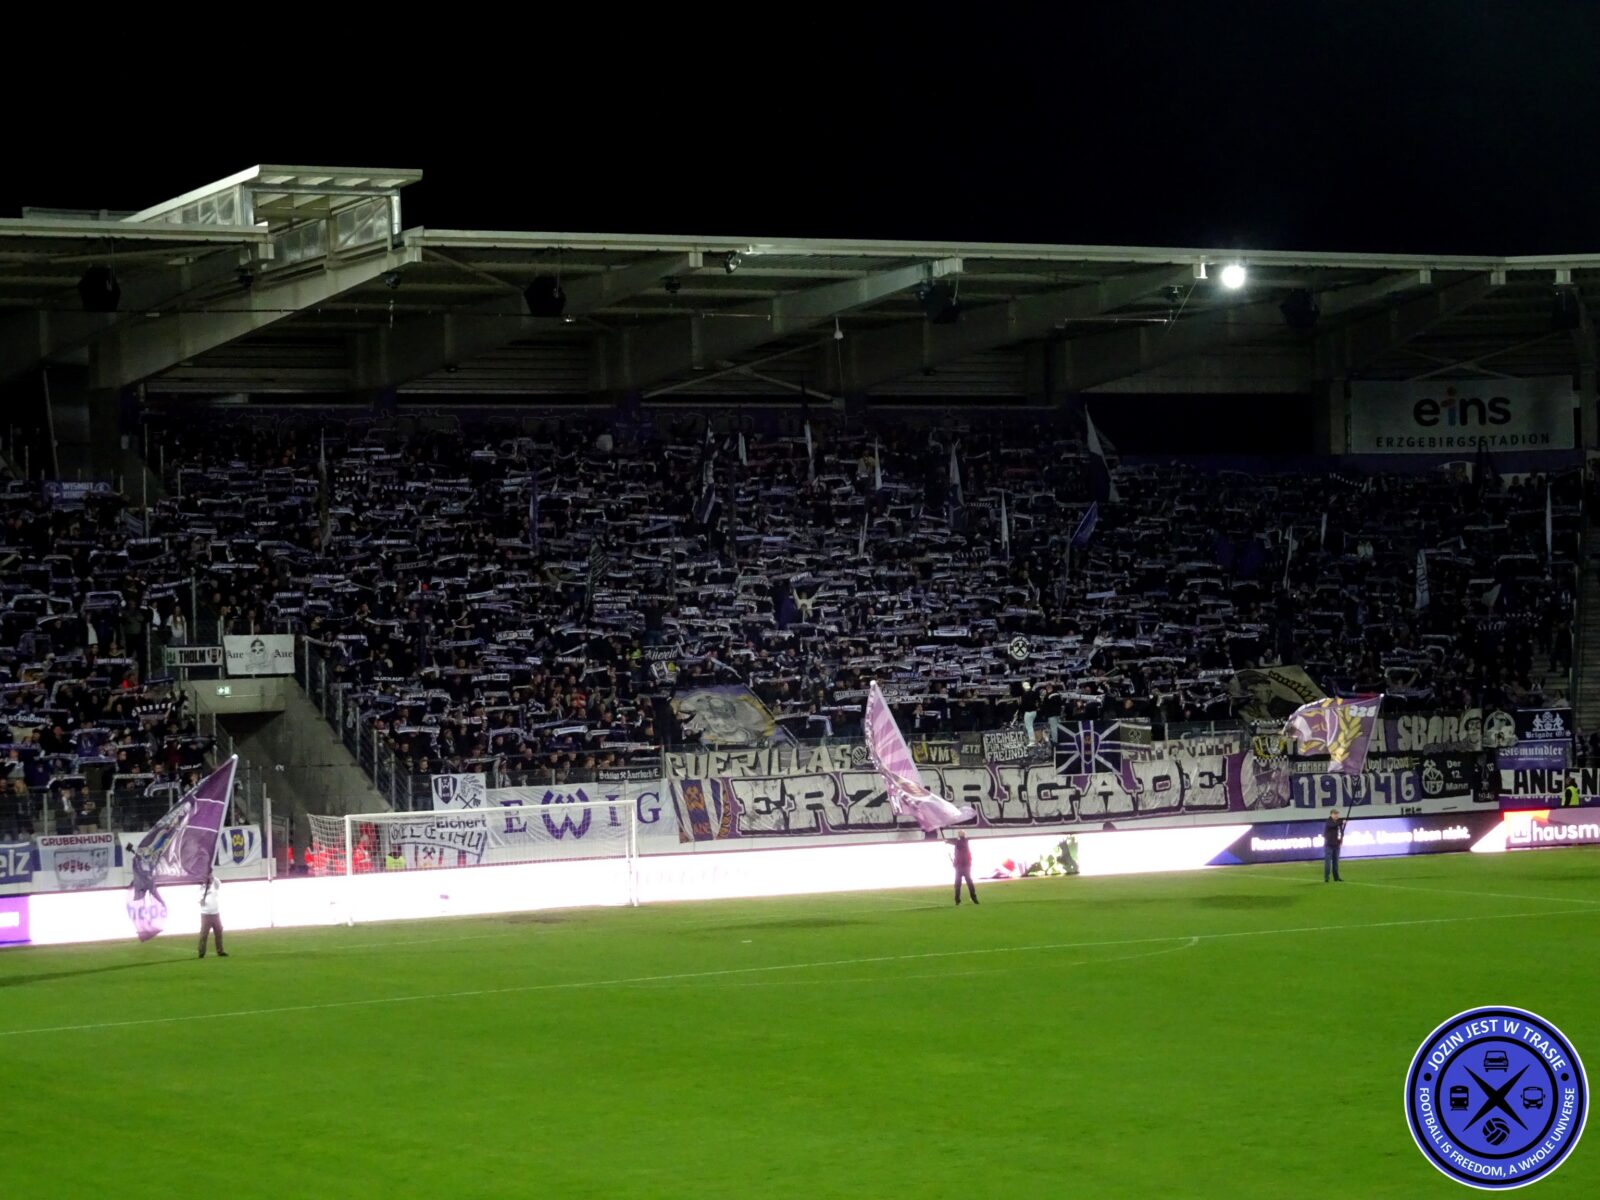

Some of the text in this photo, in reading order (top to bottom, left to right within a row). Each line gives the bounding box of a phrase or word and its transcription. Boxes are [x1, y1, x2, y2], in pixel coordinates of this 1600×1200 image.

[1413, 386, 1511, 426] eins
[1377, 432, 1550, 448] ERZGEBIRGSSTADION
[274, 649, 293, 658] Aue
[983, 731, 1024, 744] FREIHEIT
[986, 746, 1029, 762] FREUNDE
[1446, 760, 1462, 769] Der
[41, 834, 113, 847] GRUBENHUND
